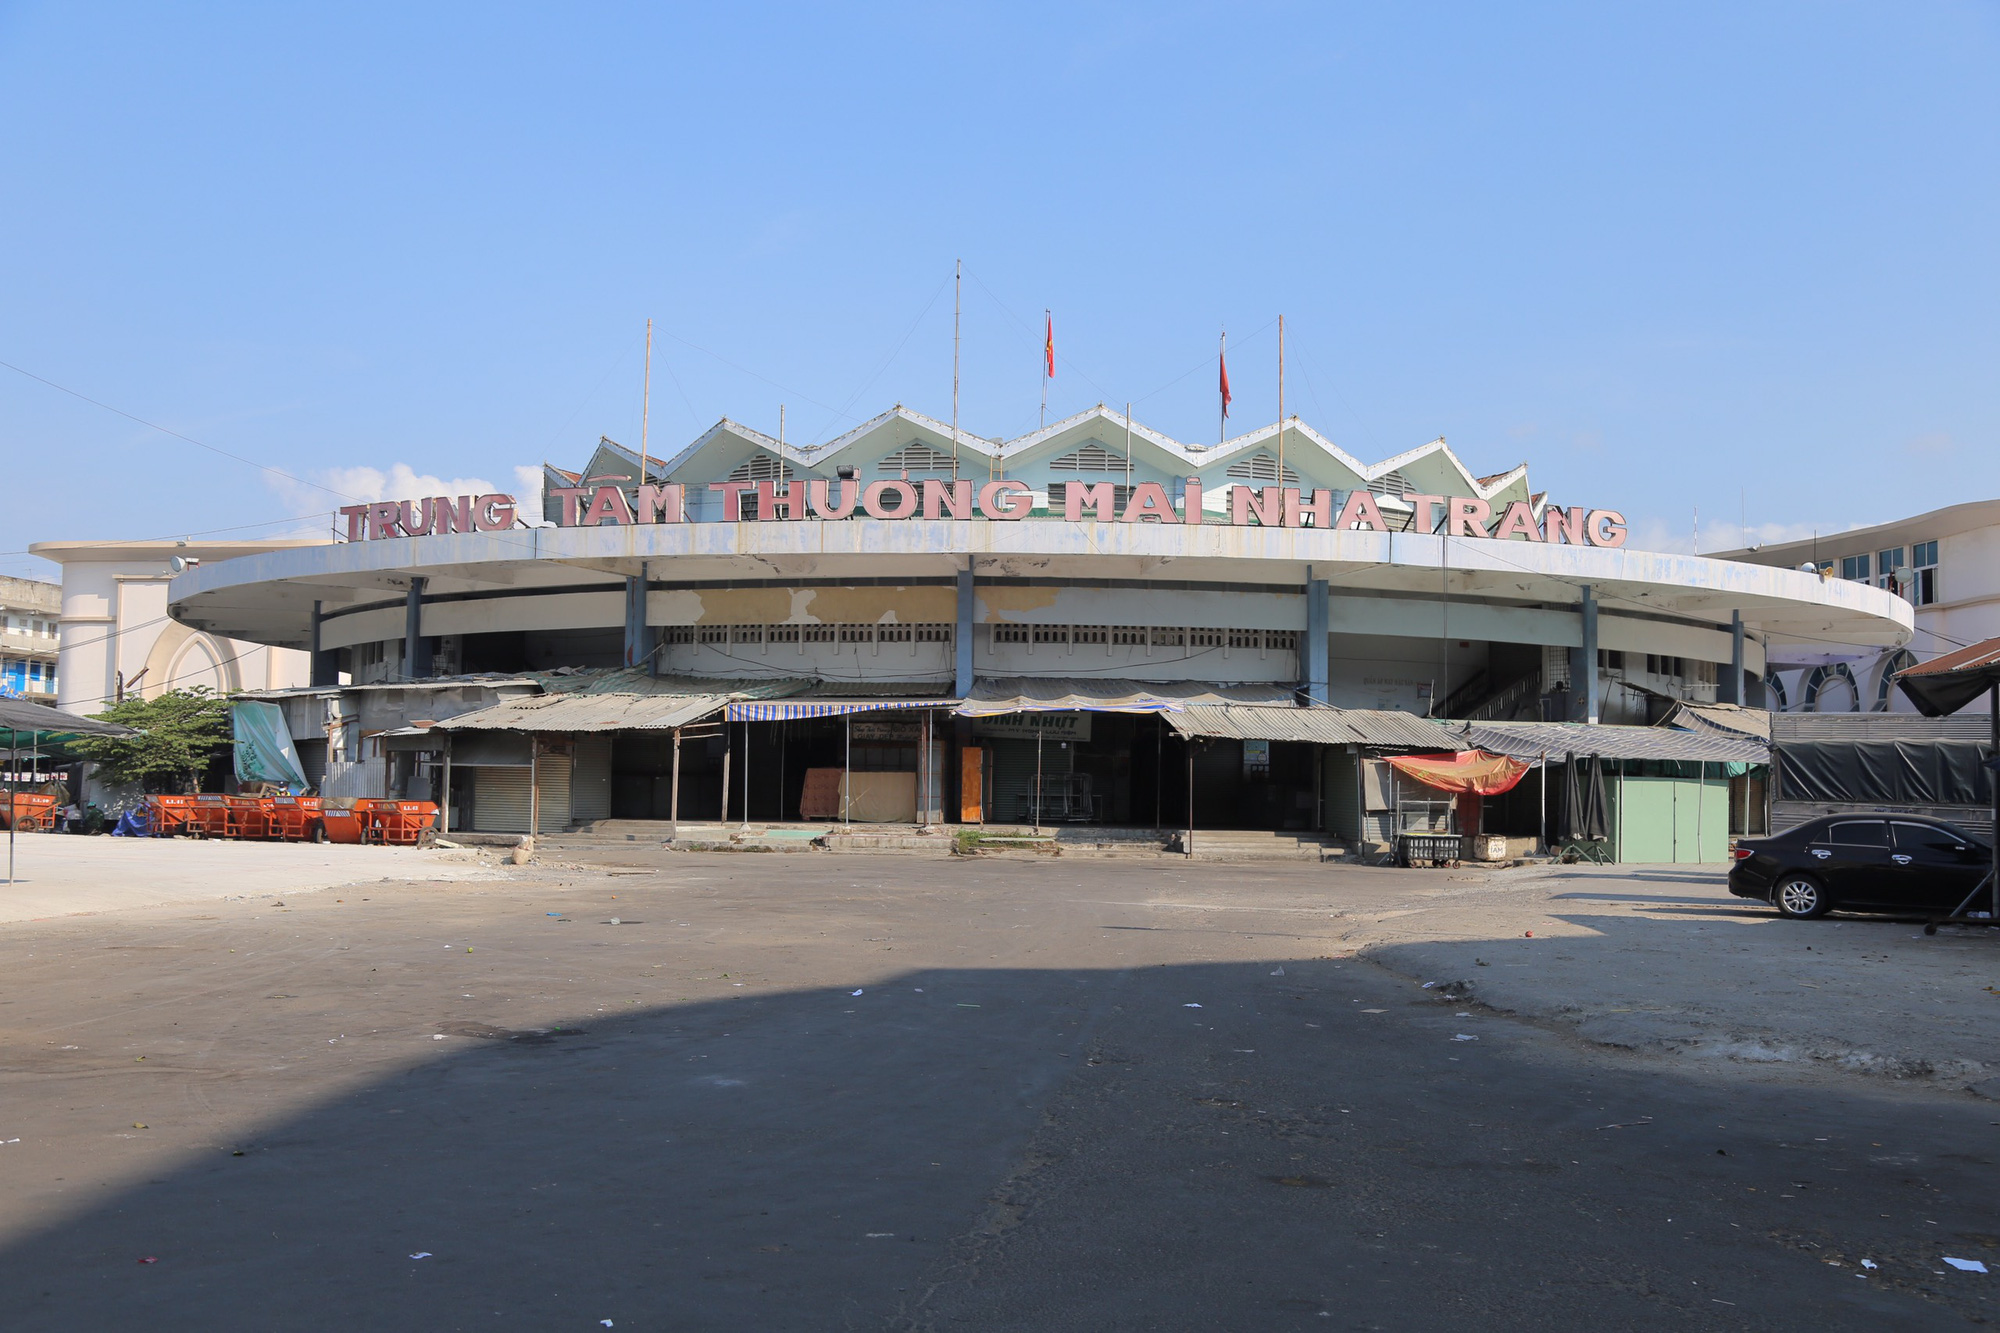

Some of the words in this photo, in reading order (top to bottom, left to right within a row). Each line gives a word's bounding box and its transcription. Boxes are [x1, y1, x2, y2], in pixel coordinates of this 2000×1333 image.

[340, 493, 516, 543] TRUNG
[1231, 486, 1389, 531] NHA
[1402, 493, 1628, 548] TRANG
